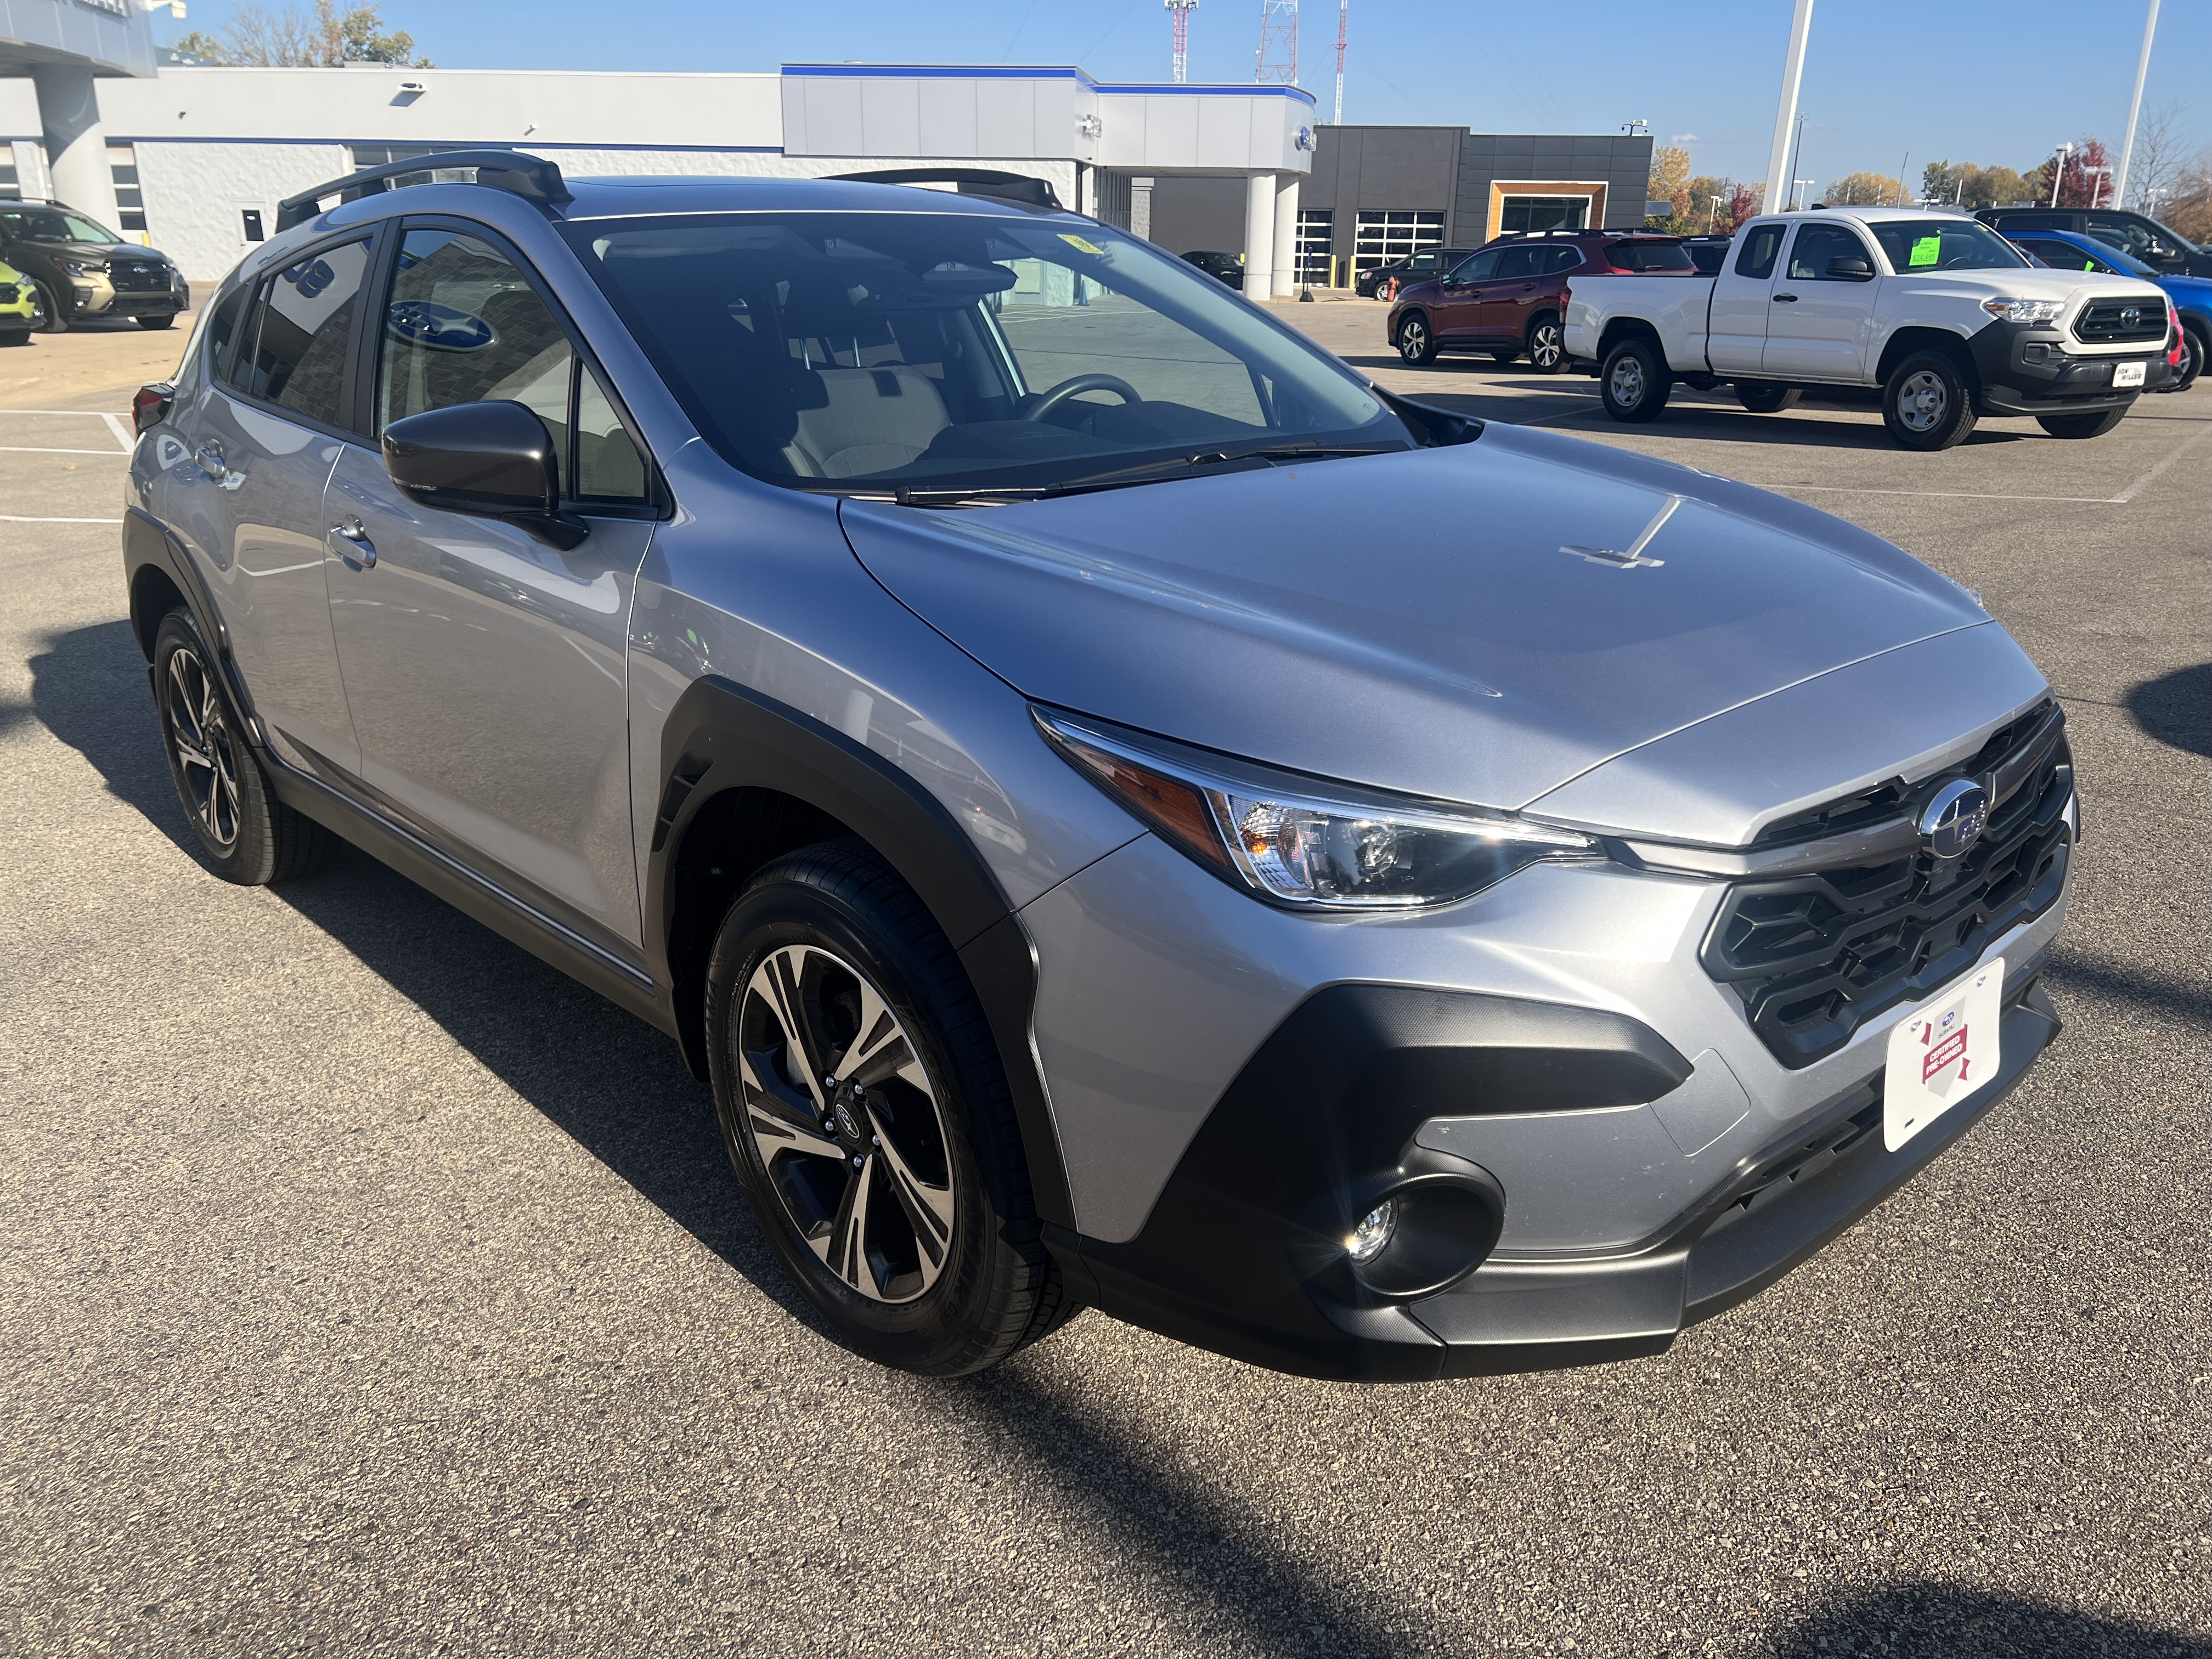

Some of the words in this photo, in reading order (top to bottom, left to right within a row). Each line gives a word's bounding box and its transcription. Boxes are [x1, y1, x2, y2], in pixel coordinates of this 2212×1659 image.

[1938, 1024, 1955, 1039] SUBARU
[1926, 1043, 1963, 1075] PRE-OWNED
[1929, 1035, 1960, 1062] CERTIFIED
